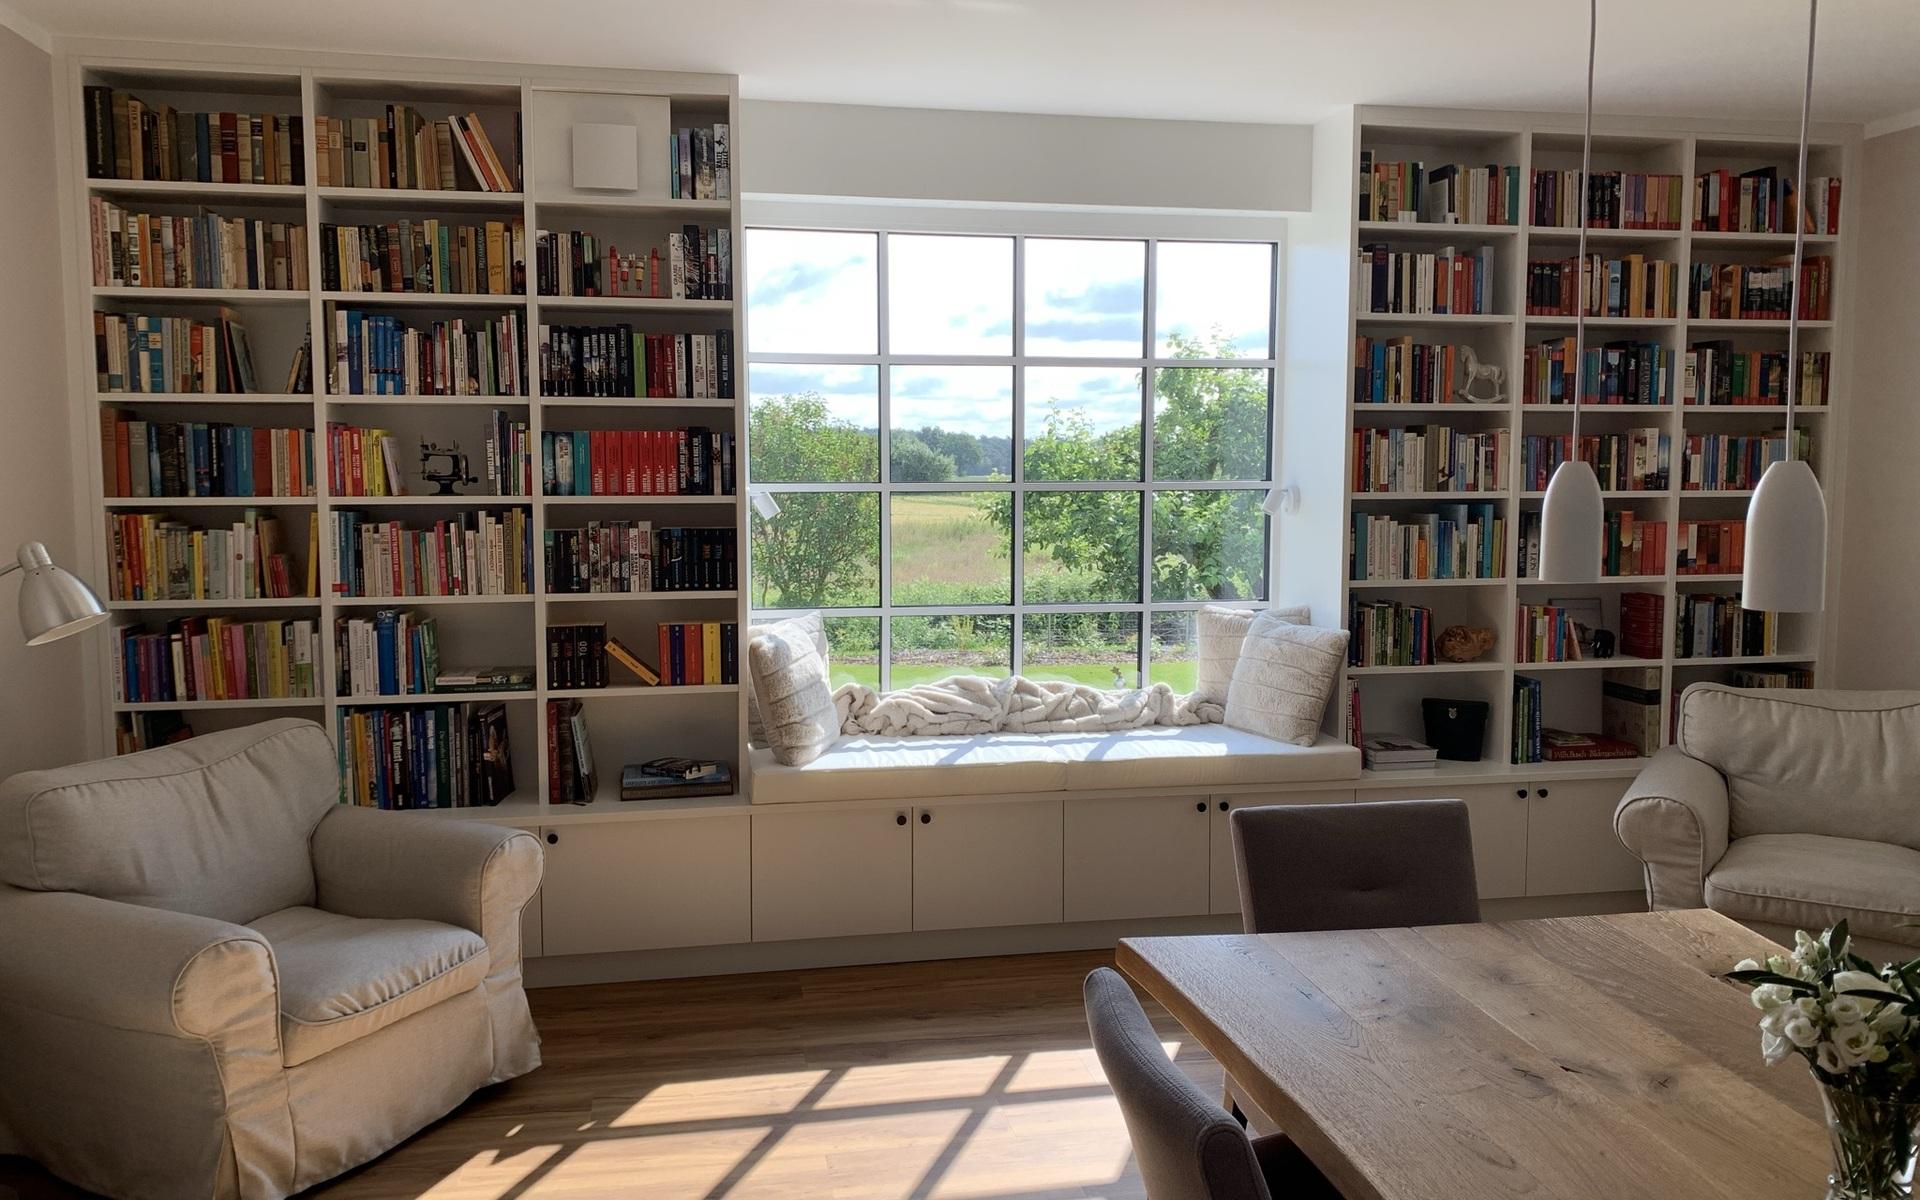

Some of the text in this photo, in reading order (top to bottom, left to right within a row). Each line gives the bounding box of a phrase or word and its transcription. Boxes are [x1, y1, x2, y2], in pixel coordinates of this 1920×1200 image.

[486, 439, 495, 480] TRAKTOREN
[578, 641, 588, 657] TOD
[393, 741, 404, 762] Kunst
